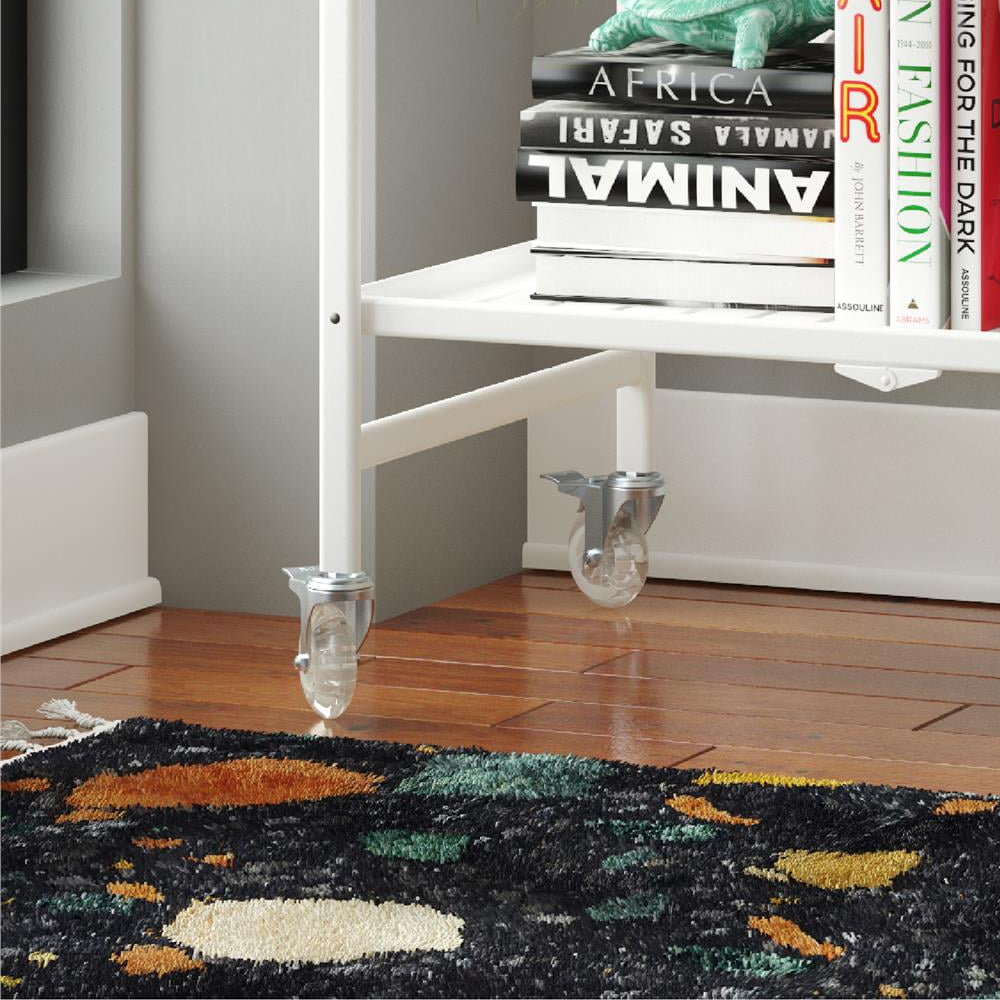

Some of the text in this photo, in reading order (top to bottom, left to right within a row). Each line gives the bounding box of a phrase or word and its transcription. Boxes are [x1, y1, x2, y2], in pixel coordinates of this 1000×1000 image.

[588, 65, 773, 107] AFRICA
[957, 59, 976, 112] FOR
[559, 115, 692, 147] SAFARI
[957, 119, 976, 172] THE
[528, 154, 831, 214] ANIMAL
[897, 60, 933, 268] FASHION
[852, 177, 864, 211] JOHN
[957, 182, 976, 255] DARK
[854, 213, 864, 265] BARRETT
[836, 302, 884, 313] ASSOULINE
[961, 268, 970, 320] ASSOULINE
